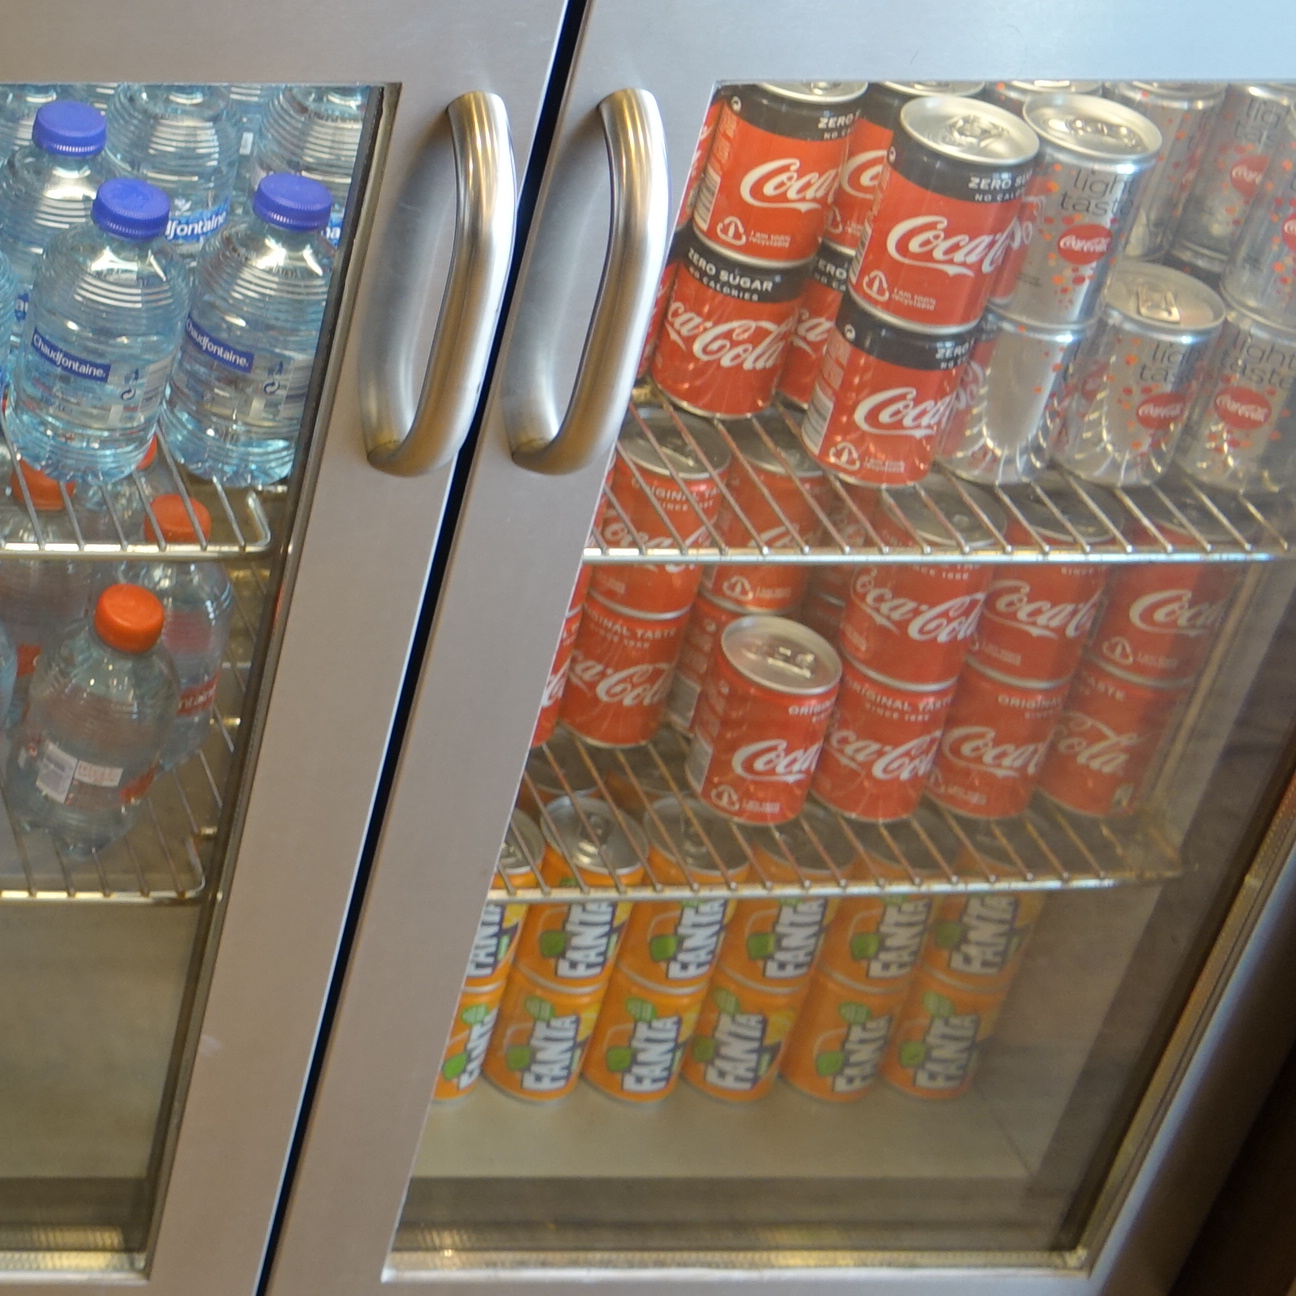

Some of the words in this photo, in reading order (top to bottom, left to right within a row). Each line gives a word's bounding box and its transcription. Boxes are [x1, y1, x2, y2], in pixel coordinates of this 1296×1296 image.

[969, 176, 1011, 190] ZERO
[720, 269, 773, 292] SUGAR
[32, 334, 106, 379] Chaudfontaine
[521, 1014, 580, 1091] FANTA
[622, 1015, 681, 1092] FANTA
[705, 1012, 765, 1091] FANTA
